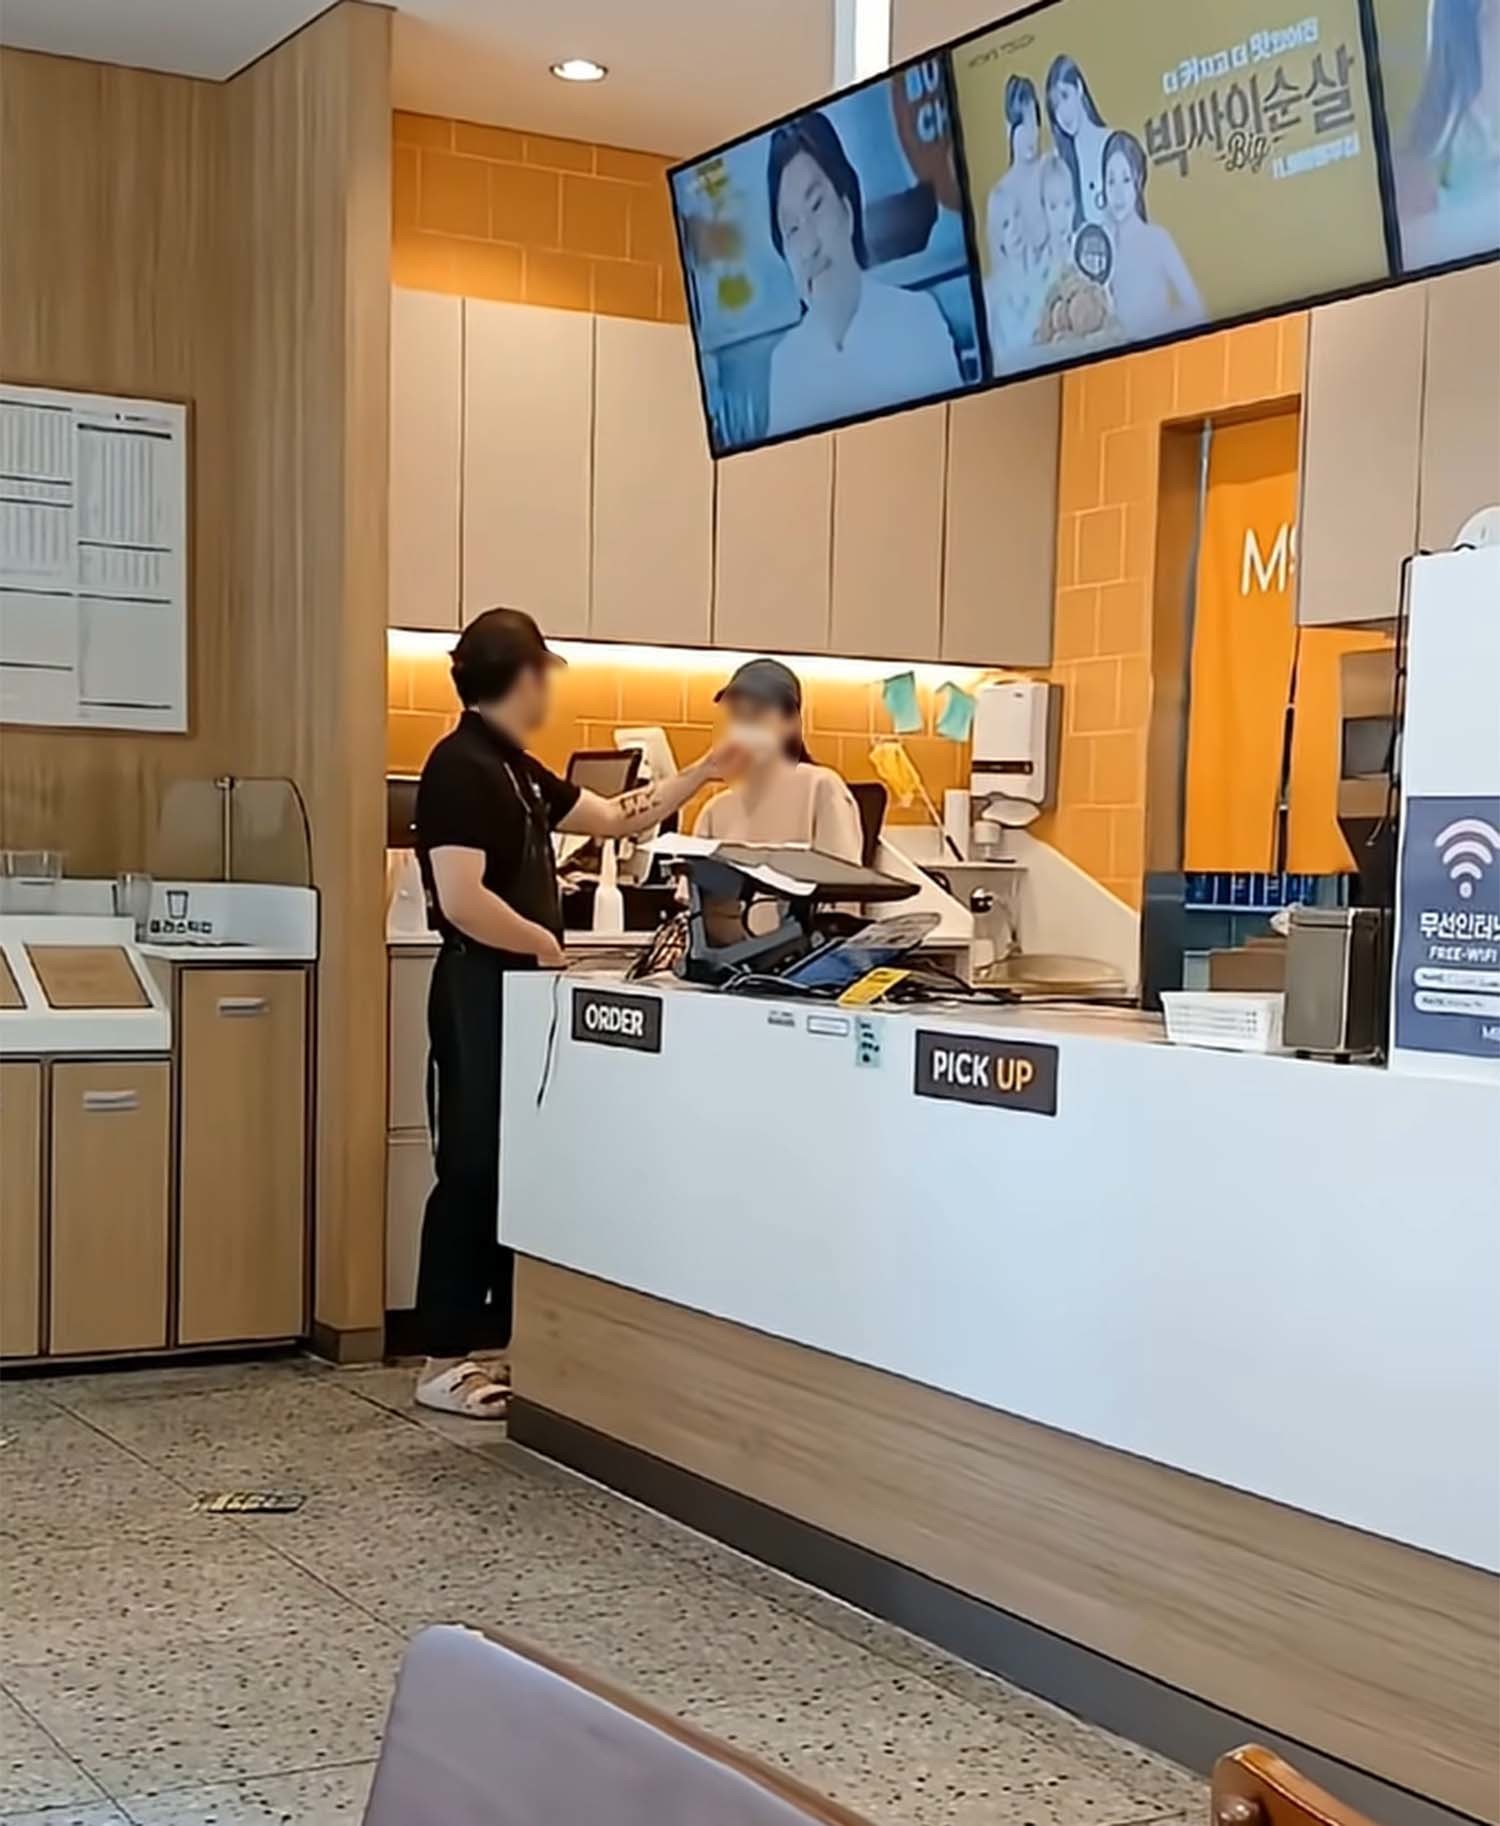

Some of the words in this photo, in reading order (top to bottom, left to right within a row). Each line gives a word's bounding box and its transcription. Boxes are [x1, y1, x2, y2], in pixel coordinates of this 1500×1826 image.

[1224, 130, 1272, 174] Big
[584, 1003, 644, 1037] ORDER
[932, 1049, 989, 1087] PICK
[995, 1056, 1033, 1091] UP
